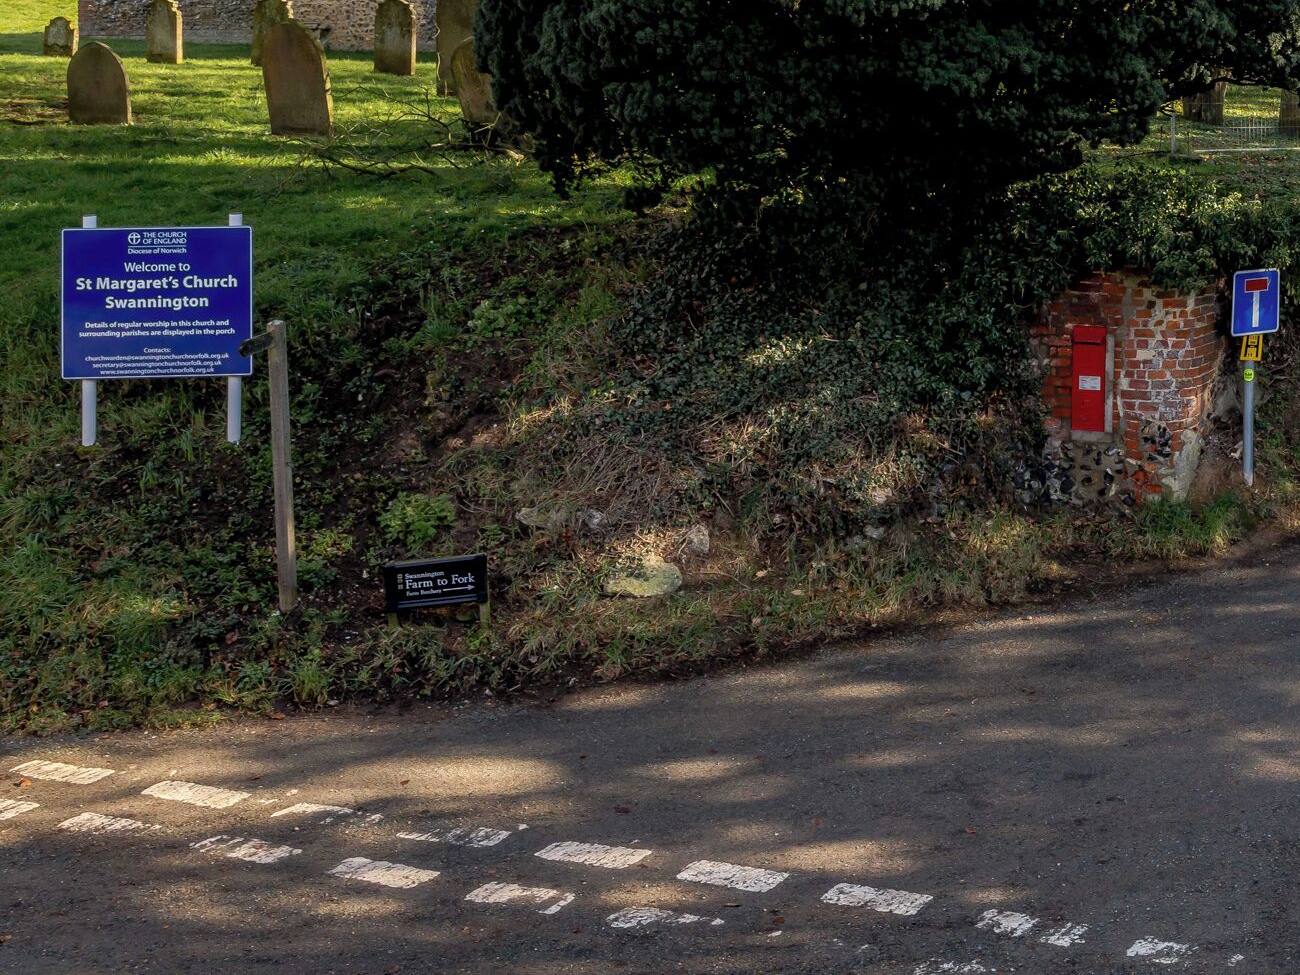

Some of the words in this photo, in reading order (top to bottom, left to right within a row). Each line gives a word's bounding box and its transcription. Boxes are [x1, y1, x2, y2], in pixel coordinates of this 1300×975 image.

[124, 262, 176, 272] Welcome
[179, 262, 191, 272] to
[76, 278, 92, 290] St
[96, 276, 179, 293] Margaret's
[183, 275, 238, 289] Church
[105, 296, 209, 311] Swannington
[118, 321, 142, 330] regular
[142, 320, 170, 329] worship
[79, 330, 120, 338] surrounding
[121, 329, 149, 337] parishes
[162, 329, 194, 337] displayed
[215, 328, 235, 336] porch
[404, 571, 445, 579] Swannington
[405, 579, 433, 589] Farm
[437, 578, 448, 586] to
[451, 572, 475, 585] Fork
